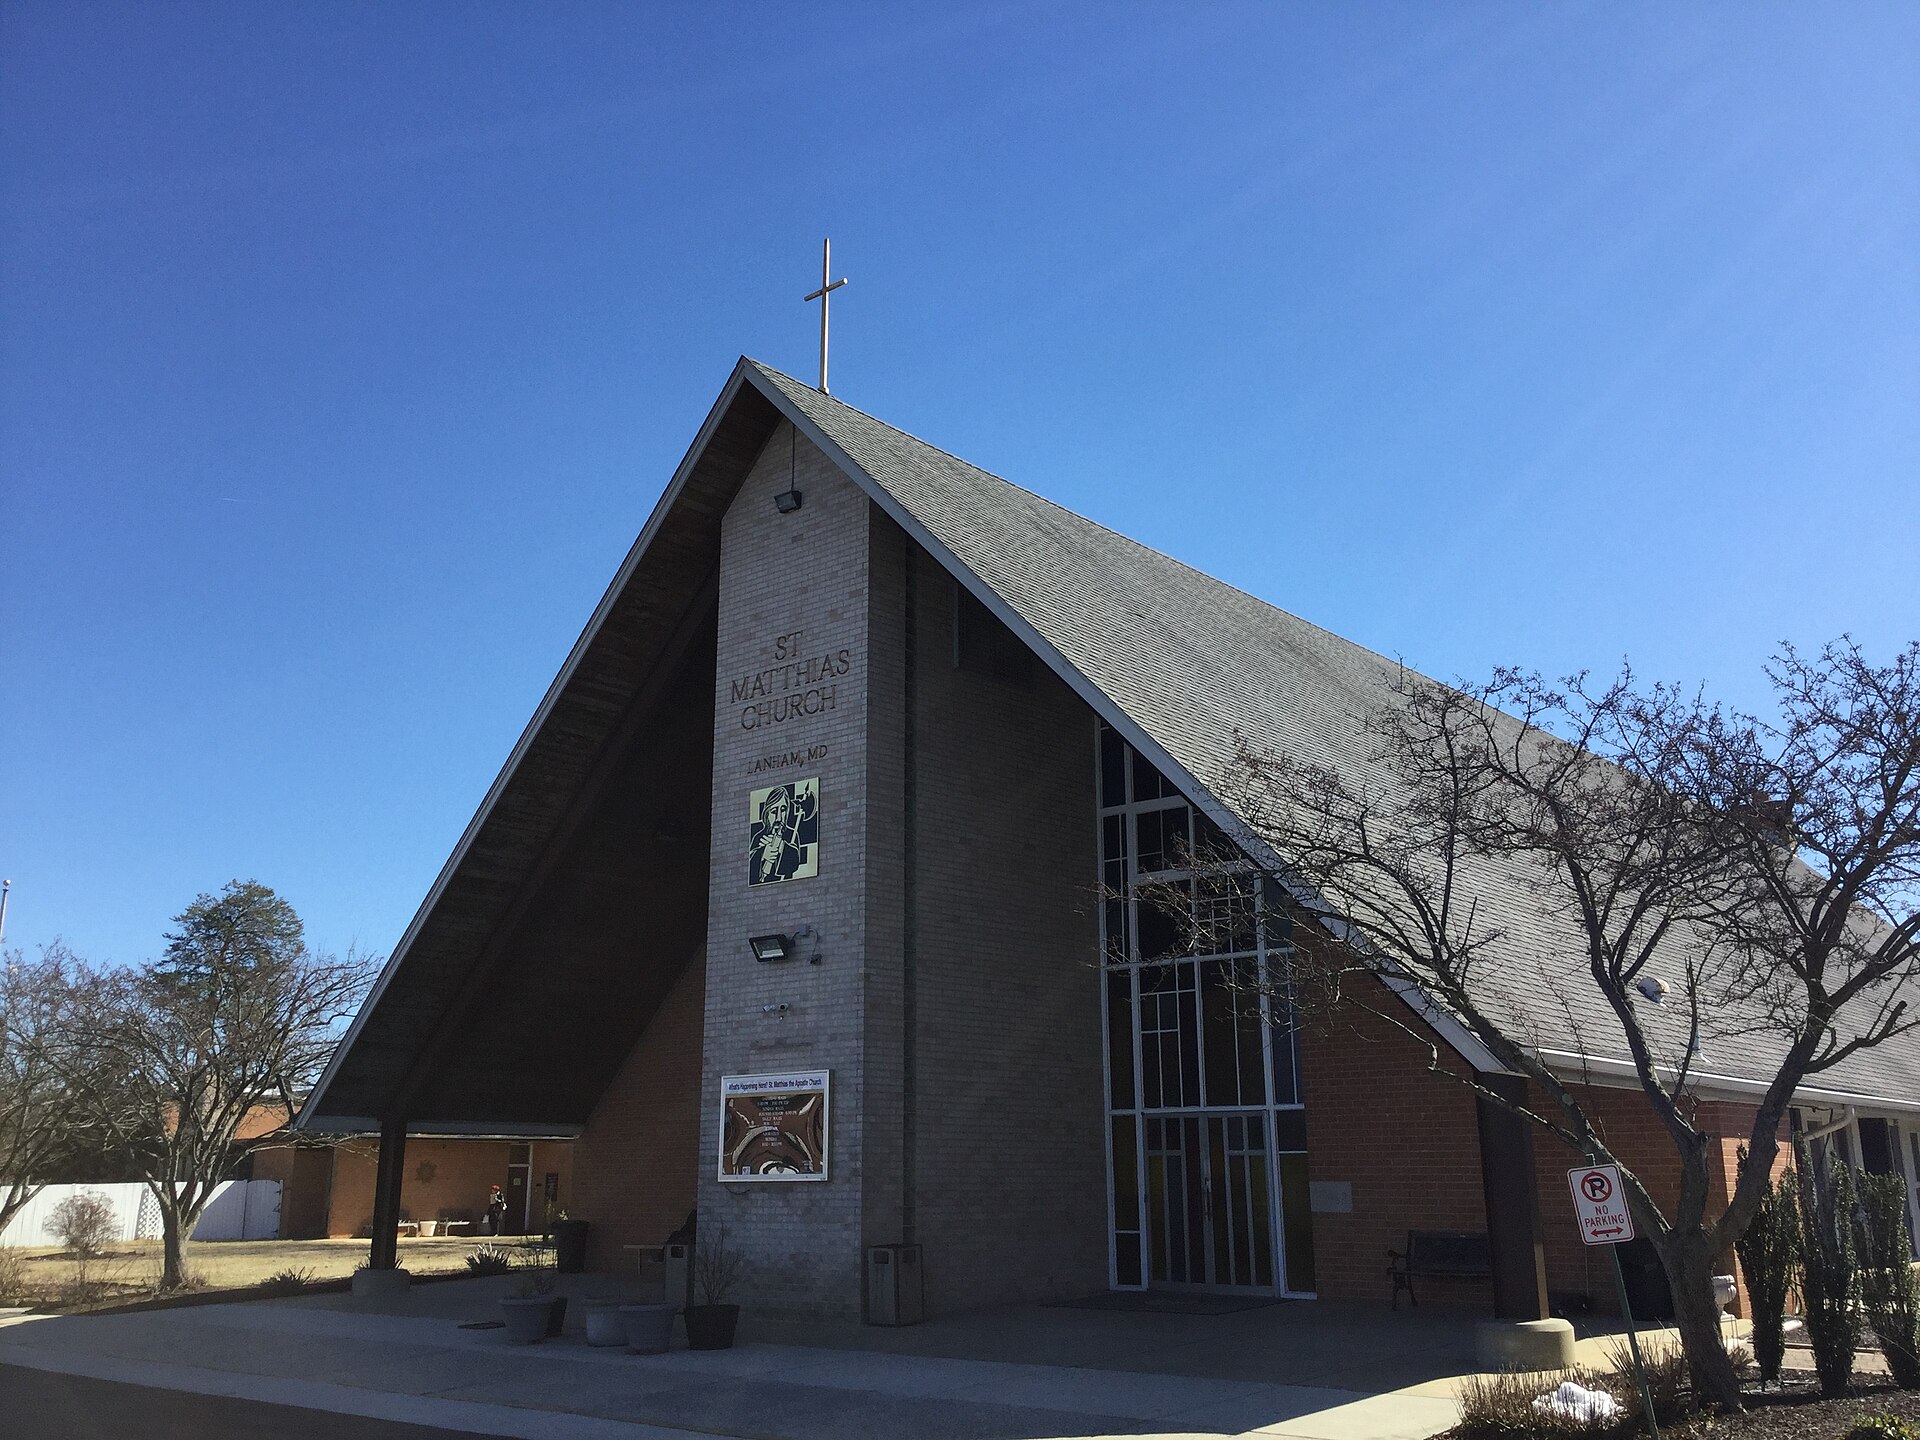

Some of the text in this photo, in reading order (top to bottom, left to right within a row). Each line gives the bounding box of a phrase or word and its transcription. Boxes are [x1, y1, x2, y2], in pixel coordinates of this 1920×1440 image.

[775, 631, 803, 660] ST
[731, 650, 850, 703] MATTHIAS
[741, 685, 837, 730] CHURCH
[747, 745, 828, 774] LANHAM, MD
[1585, 1214, 1624, 1227] PARKING
[1595, 1205, 1609, 1215] NO
